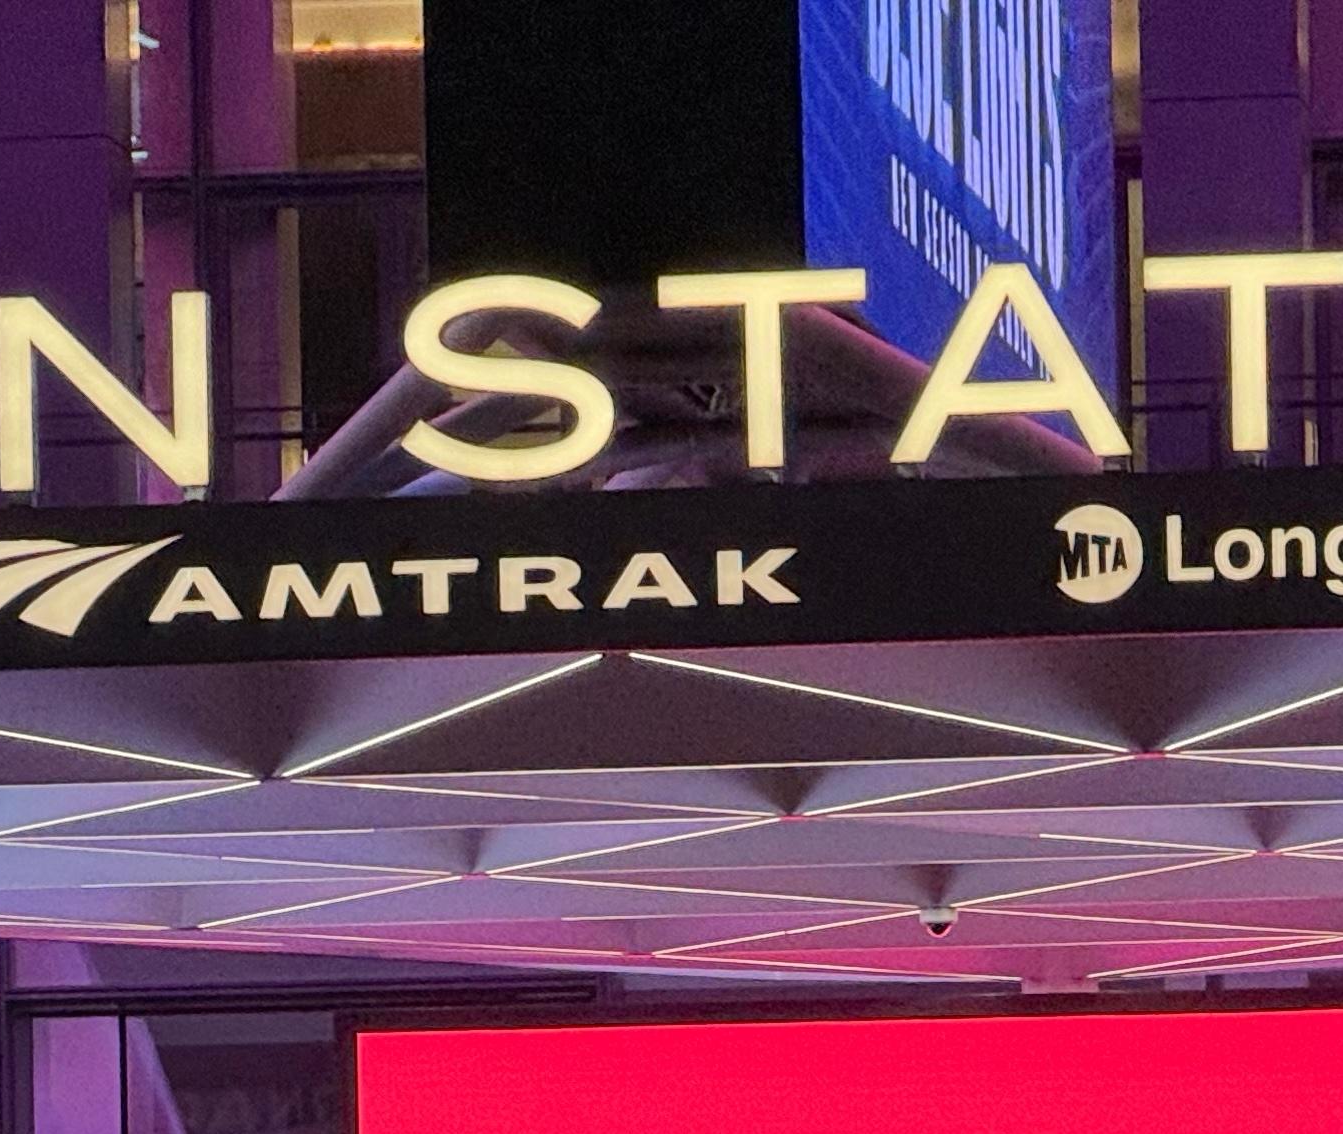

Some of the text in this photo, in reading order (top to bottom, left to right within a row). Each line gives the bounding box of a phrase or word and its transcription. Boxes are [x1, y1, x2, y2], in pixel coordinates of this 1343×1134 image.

[891, 153, 971, 301] NEW SEASON
[148, 546, 801, 625] AMTRAK
[1053, 529, 1128, 584] MTA
